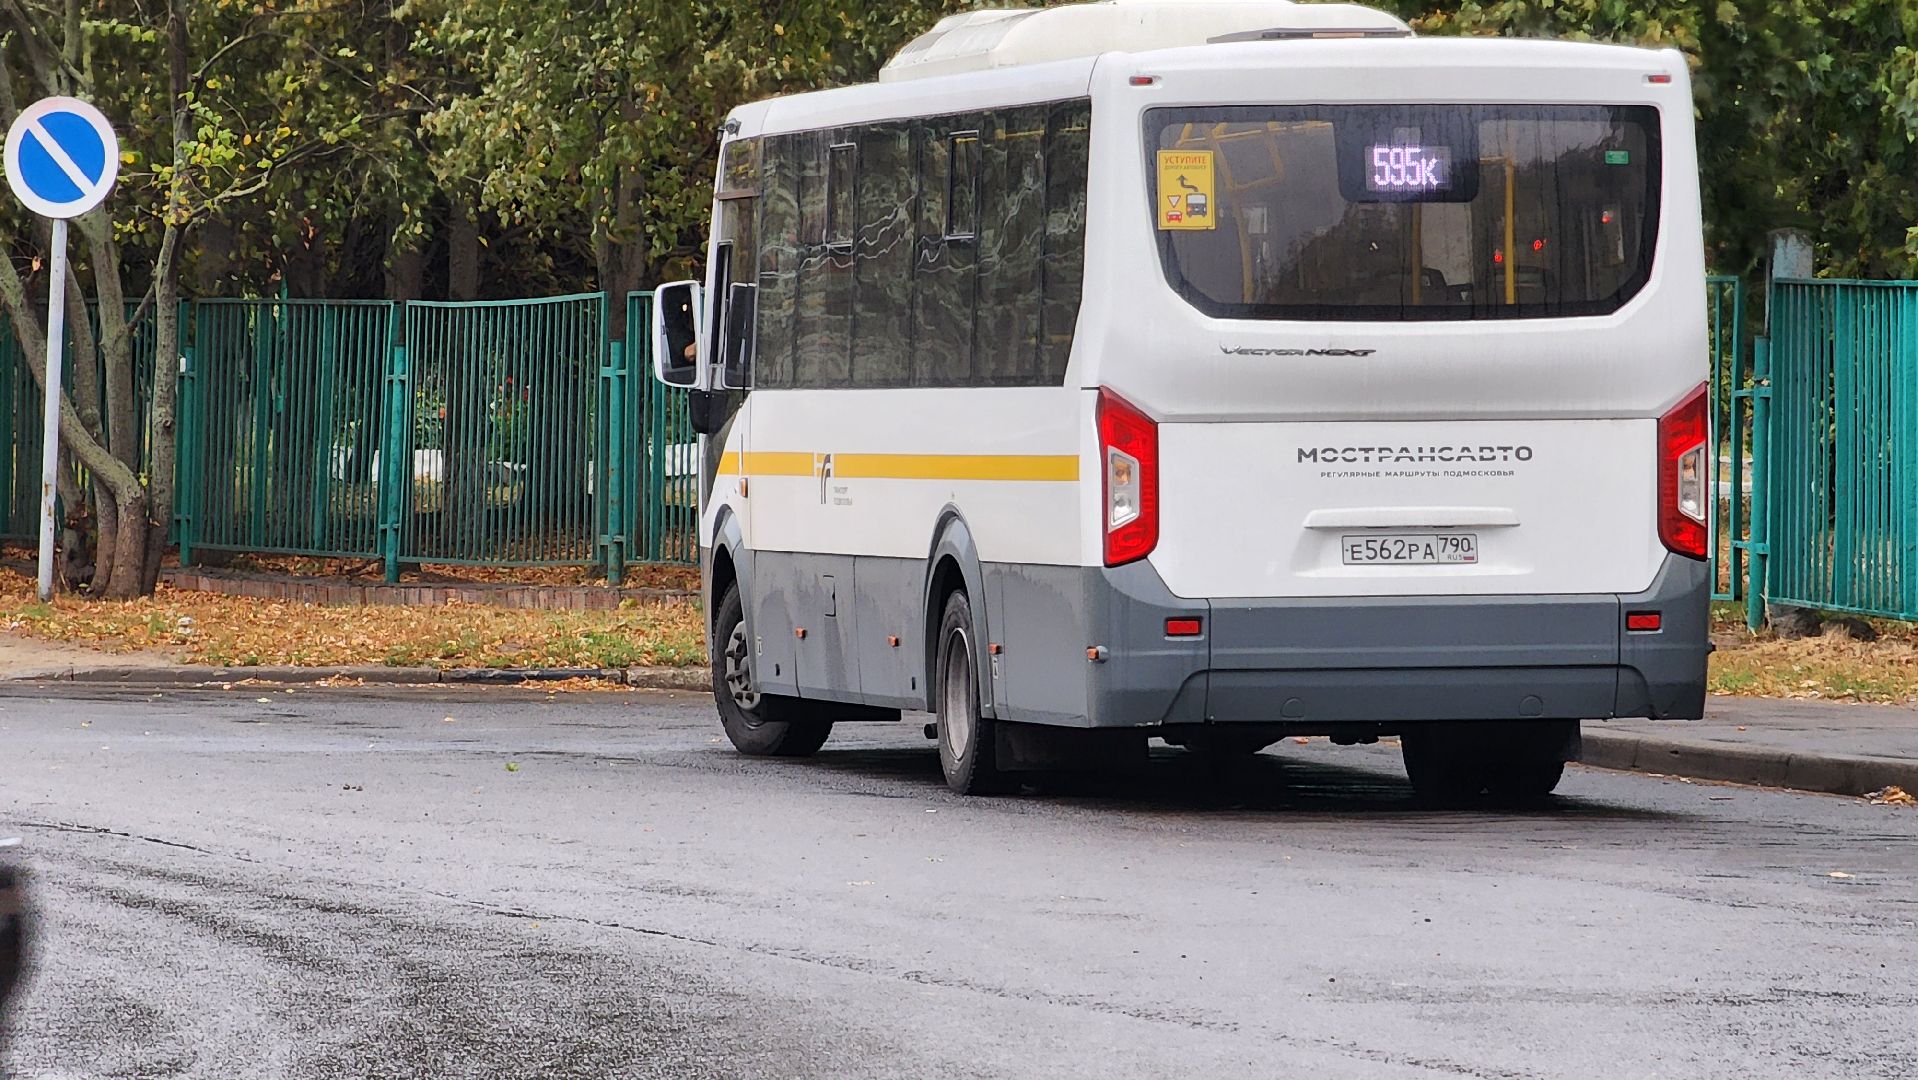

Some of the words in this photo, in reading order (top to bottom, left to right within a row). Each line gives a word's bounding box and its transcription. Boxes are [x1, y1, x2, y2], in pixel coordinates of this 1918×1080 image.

[1165, 156, 1207, 165] УСТУПИТЕ
[1297, 446, 1533, 463] МОСТРАНСАВТО
[1438, 537, 1471, 553] 790
